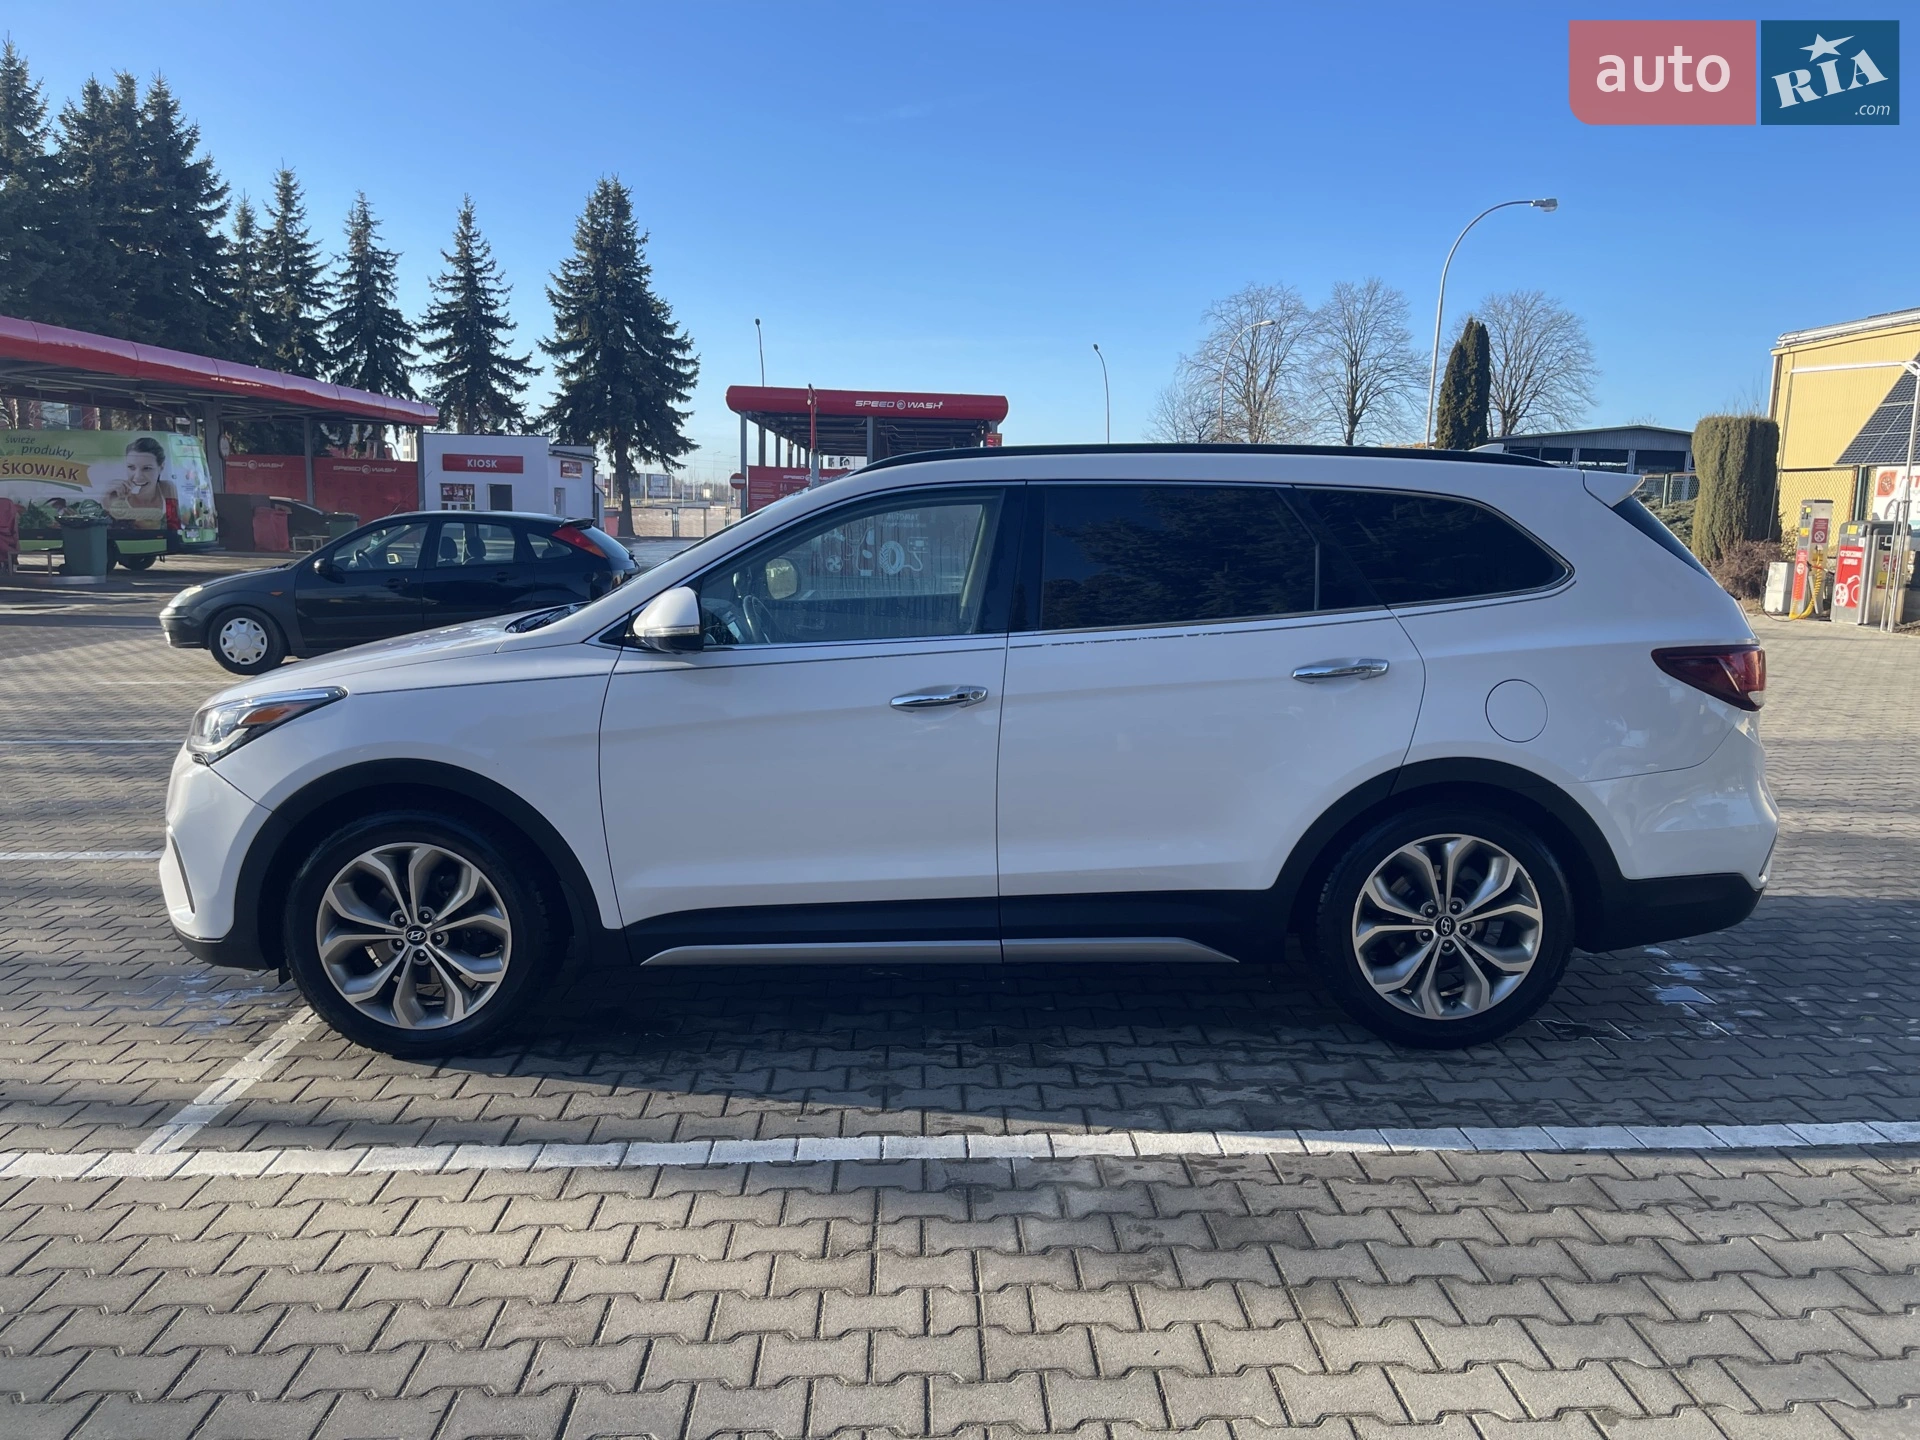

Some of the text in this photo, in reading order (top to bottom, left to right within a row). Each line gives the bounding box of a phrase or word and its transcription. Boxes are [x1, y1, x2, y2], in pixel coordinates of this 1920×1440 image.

[855, 399, 944, 409] SPEED WASH
[21, 444, 75, 460] produkty
[2, 459, 80, 480] ŚKOWIAK
[467, 458, 498, 468] KIOSK
